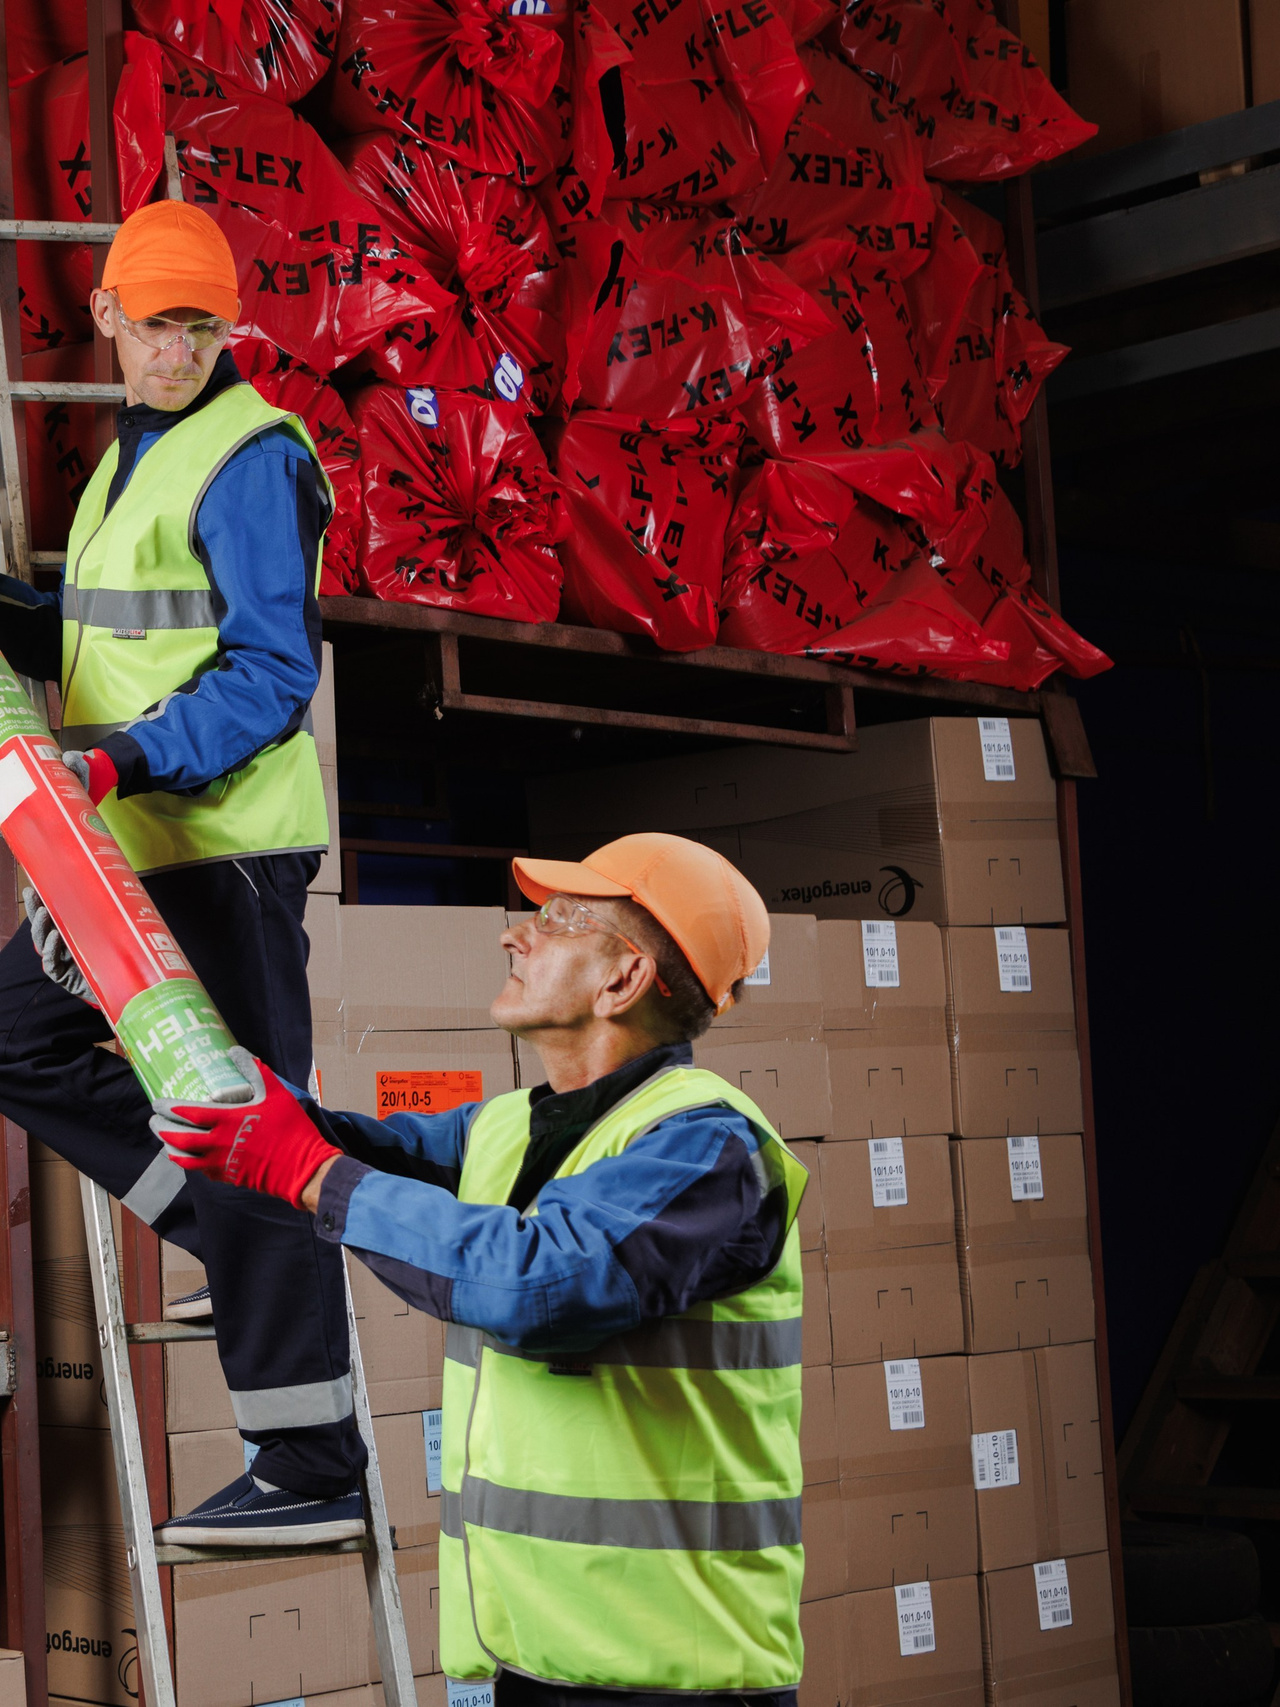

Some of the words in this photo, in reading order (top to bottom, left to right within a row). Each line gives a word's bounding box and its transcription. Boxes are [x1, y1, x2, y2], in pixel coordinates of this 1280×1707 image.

[175, 140, 305, 194] K-FLEX
[983, 743, 1011, 753] 10/1,0-10
[781, 880, 872, 904] energoflex
[865, 947, 896, 957] 10/1,0-10
[999, 953, 1028, 963] 10/1,0-10
[134, 1008, 225, 1063] СТЕН
[172, 1034, 212, 1060] для
[381, 1091, 431, 1109] 20/1,0-5
[873, 1165, 903, 1176] 10/1,0-10
[1011, 1160, 1039, 1170] 10/1,0-10
[889, 1387, 921, 1398] 10/1,0-10
[992, 1435, 1000, 1483] 10/1,0-10
[1039, 1586, 1068, 1599] 10/1,0-10
[900, 1610, 931, 1623] 10/1,0-10
